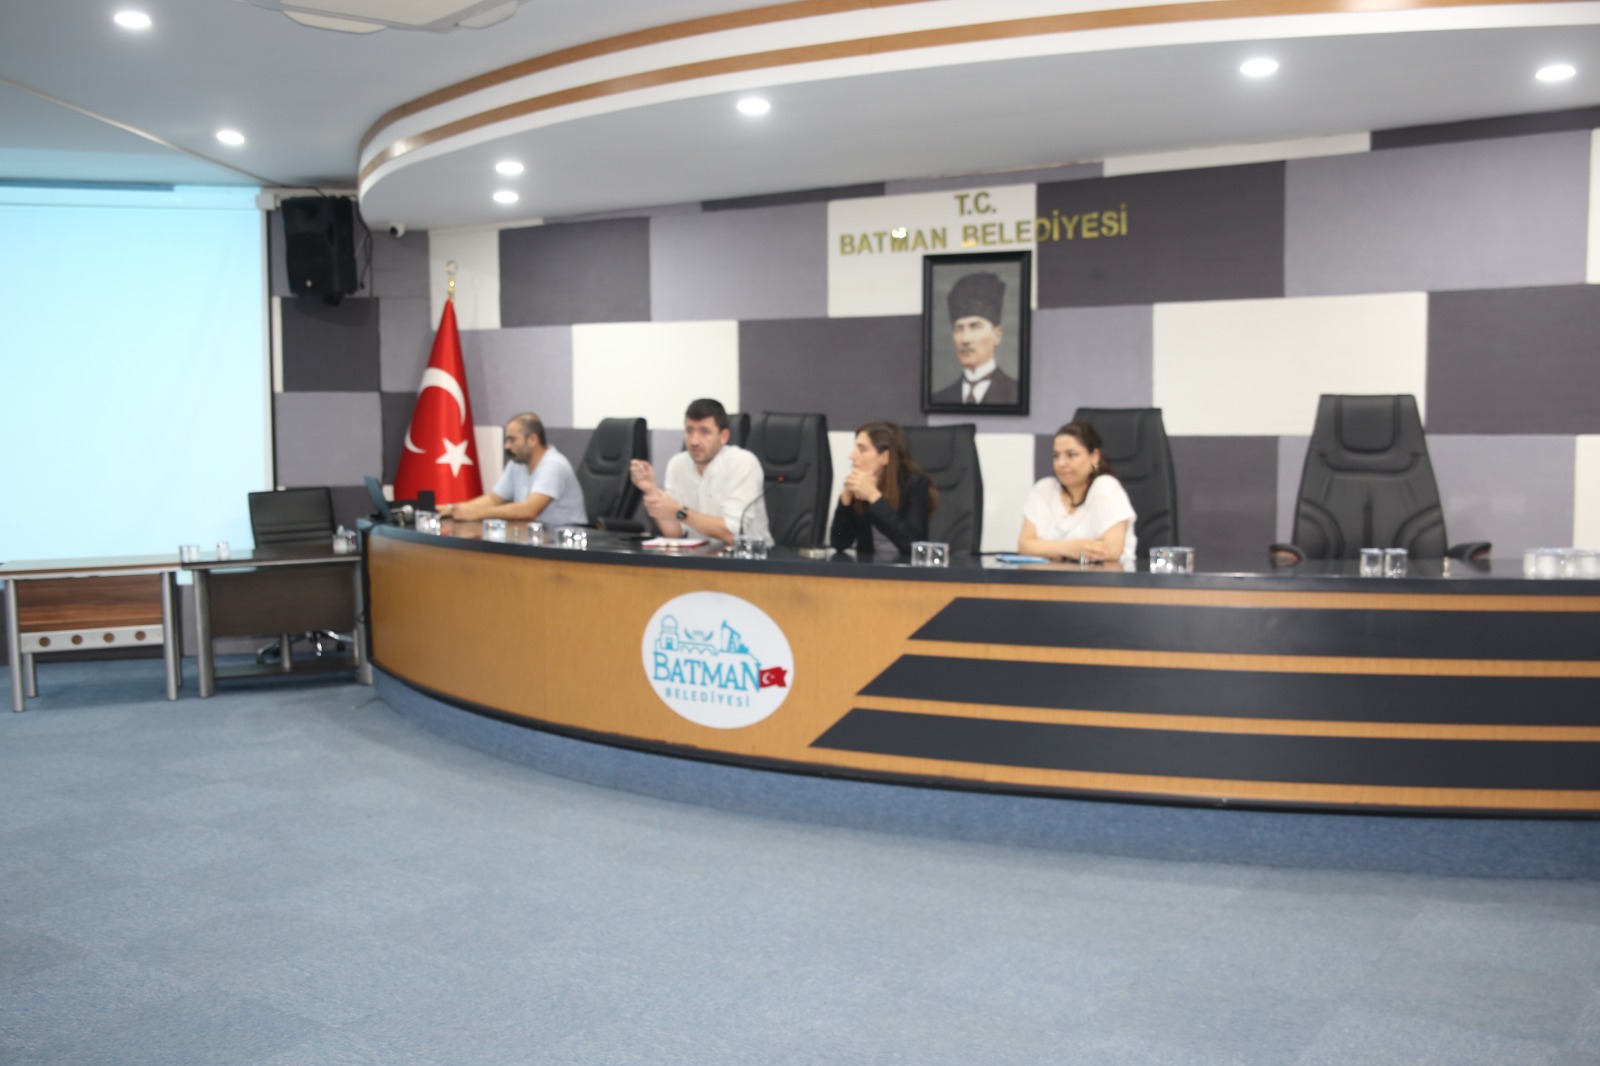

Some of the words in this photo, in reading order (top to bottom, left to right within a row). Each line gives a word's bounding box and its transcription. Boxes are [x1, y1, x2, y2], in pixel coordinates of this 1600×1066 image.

[954, 191, 997, 216] T.C.
[839, 227, 947, 256] BATMAN
[962, 203, 1129, 248] BELEDİYESİ
[652, 651, 760, 692] BATMAN
[665, 687, 751, 708] BELEDİYESİ
